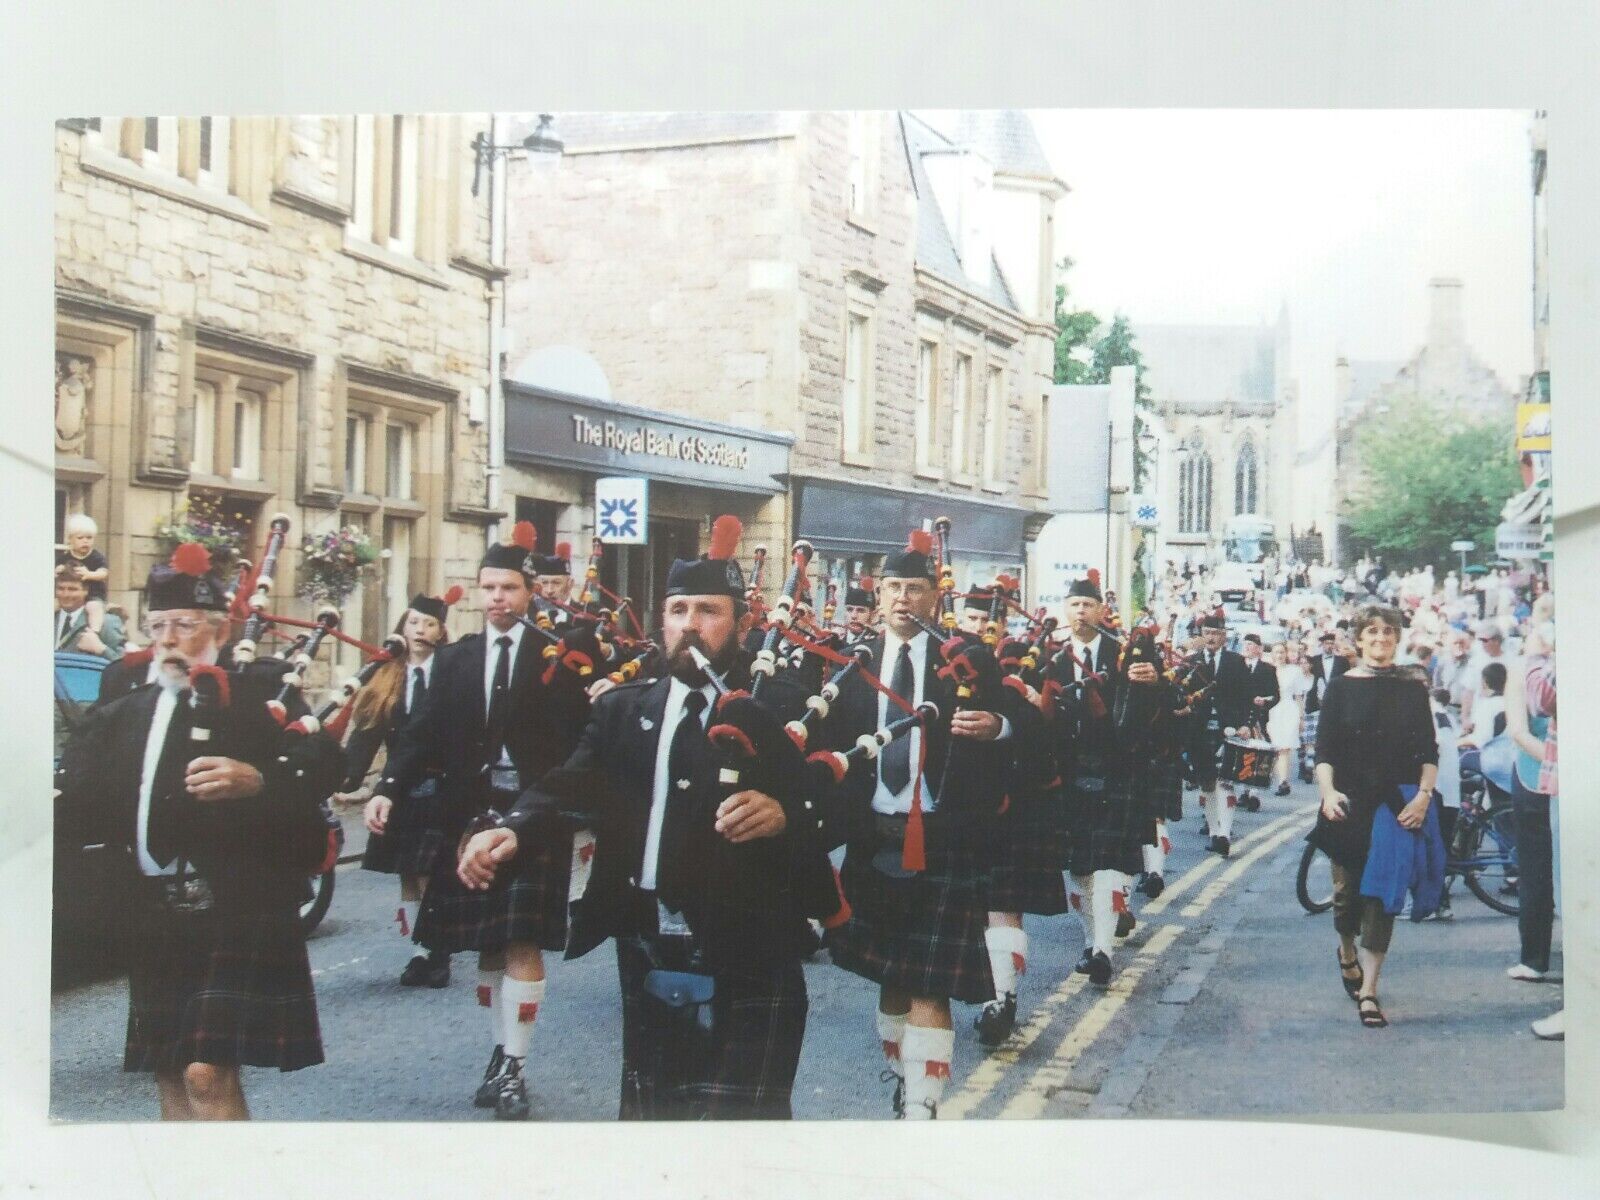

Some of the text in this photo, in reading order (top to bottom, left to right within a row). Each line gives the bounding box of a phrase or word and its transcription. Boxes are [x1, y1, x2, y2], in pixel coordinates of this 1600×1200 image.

[572, 414, 749, 469] The Royal Bank of Scotland
